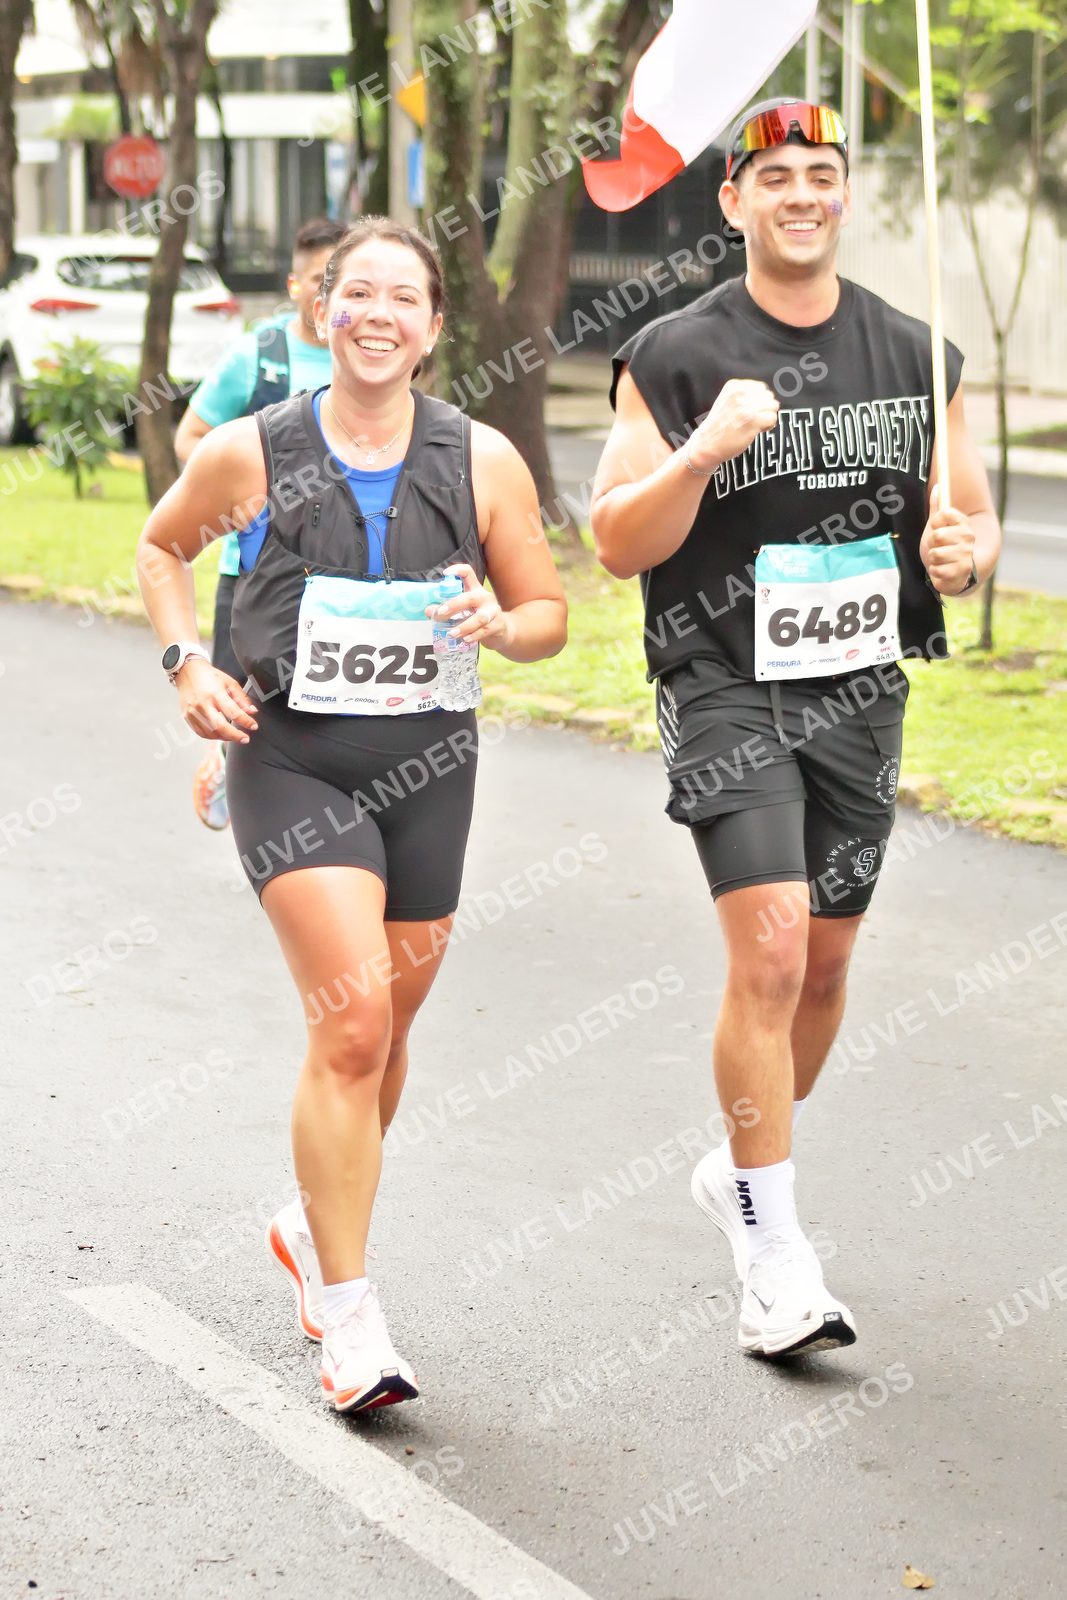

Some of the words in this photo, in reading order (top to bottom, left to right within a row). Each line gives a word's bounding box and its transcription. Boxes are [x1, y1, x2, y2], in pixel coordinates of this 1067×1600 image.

[818, 395, 930, 482] SOCIETY
[797, 470, 868, 491] TORONTO
[768, 593, 887, 648] 6489
[305, 640, 439, 685] 5625
[767, 659, 802, 668] PERDURA
[301, 693, 338, 703] PERDURA
[417, 699, 437, 711] 5625
